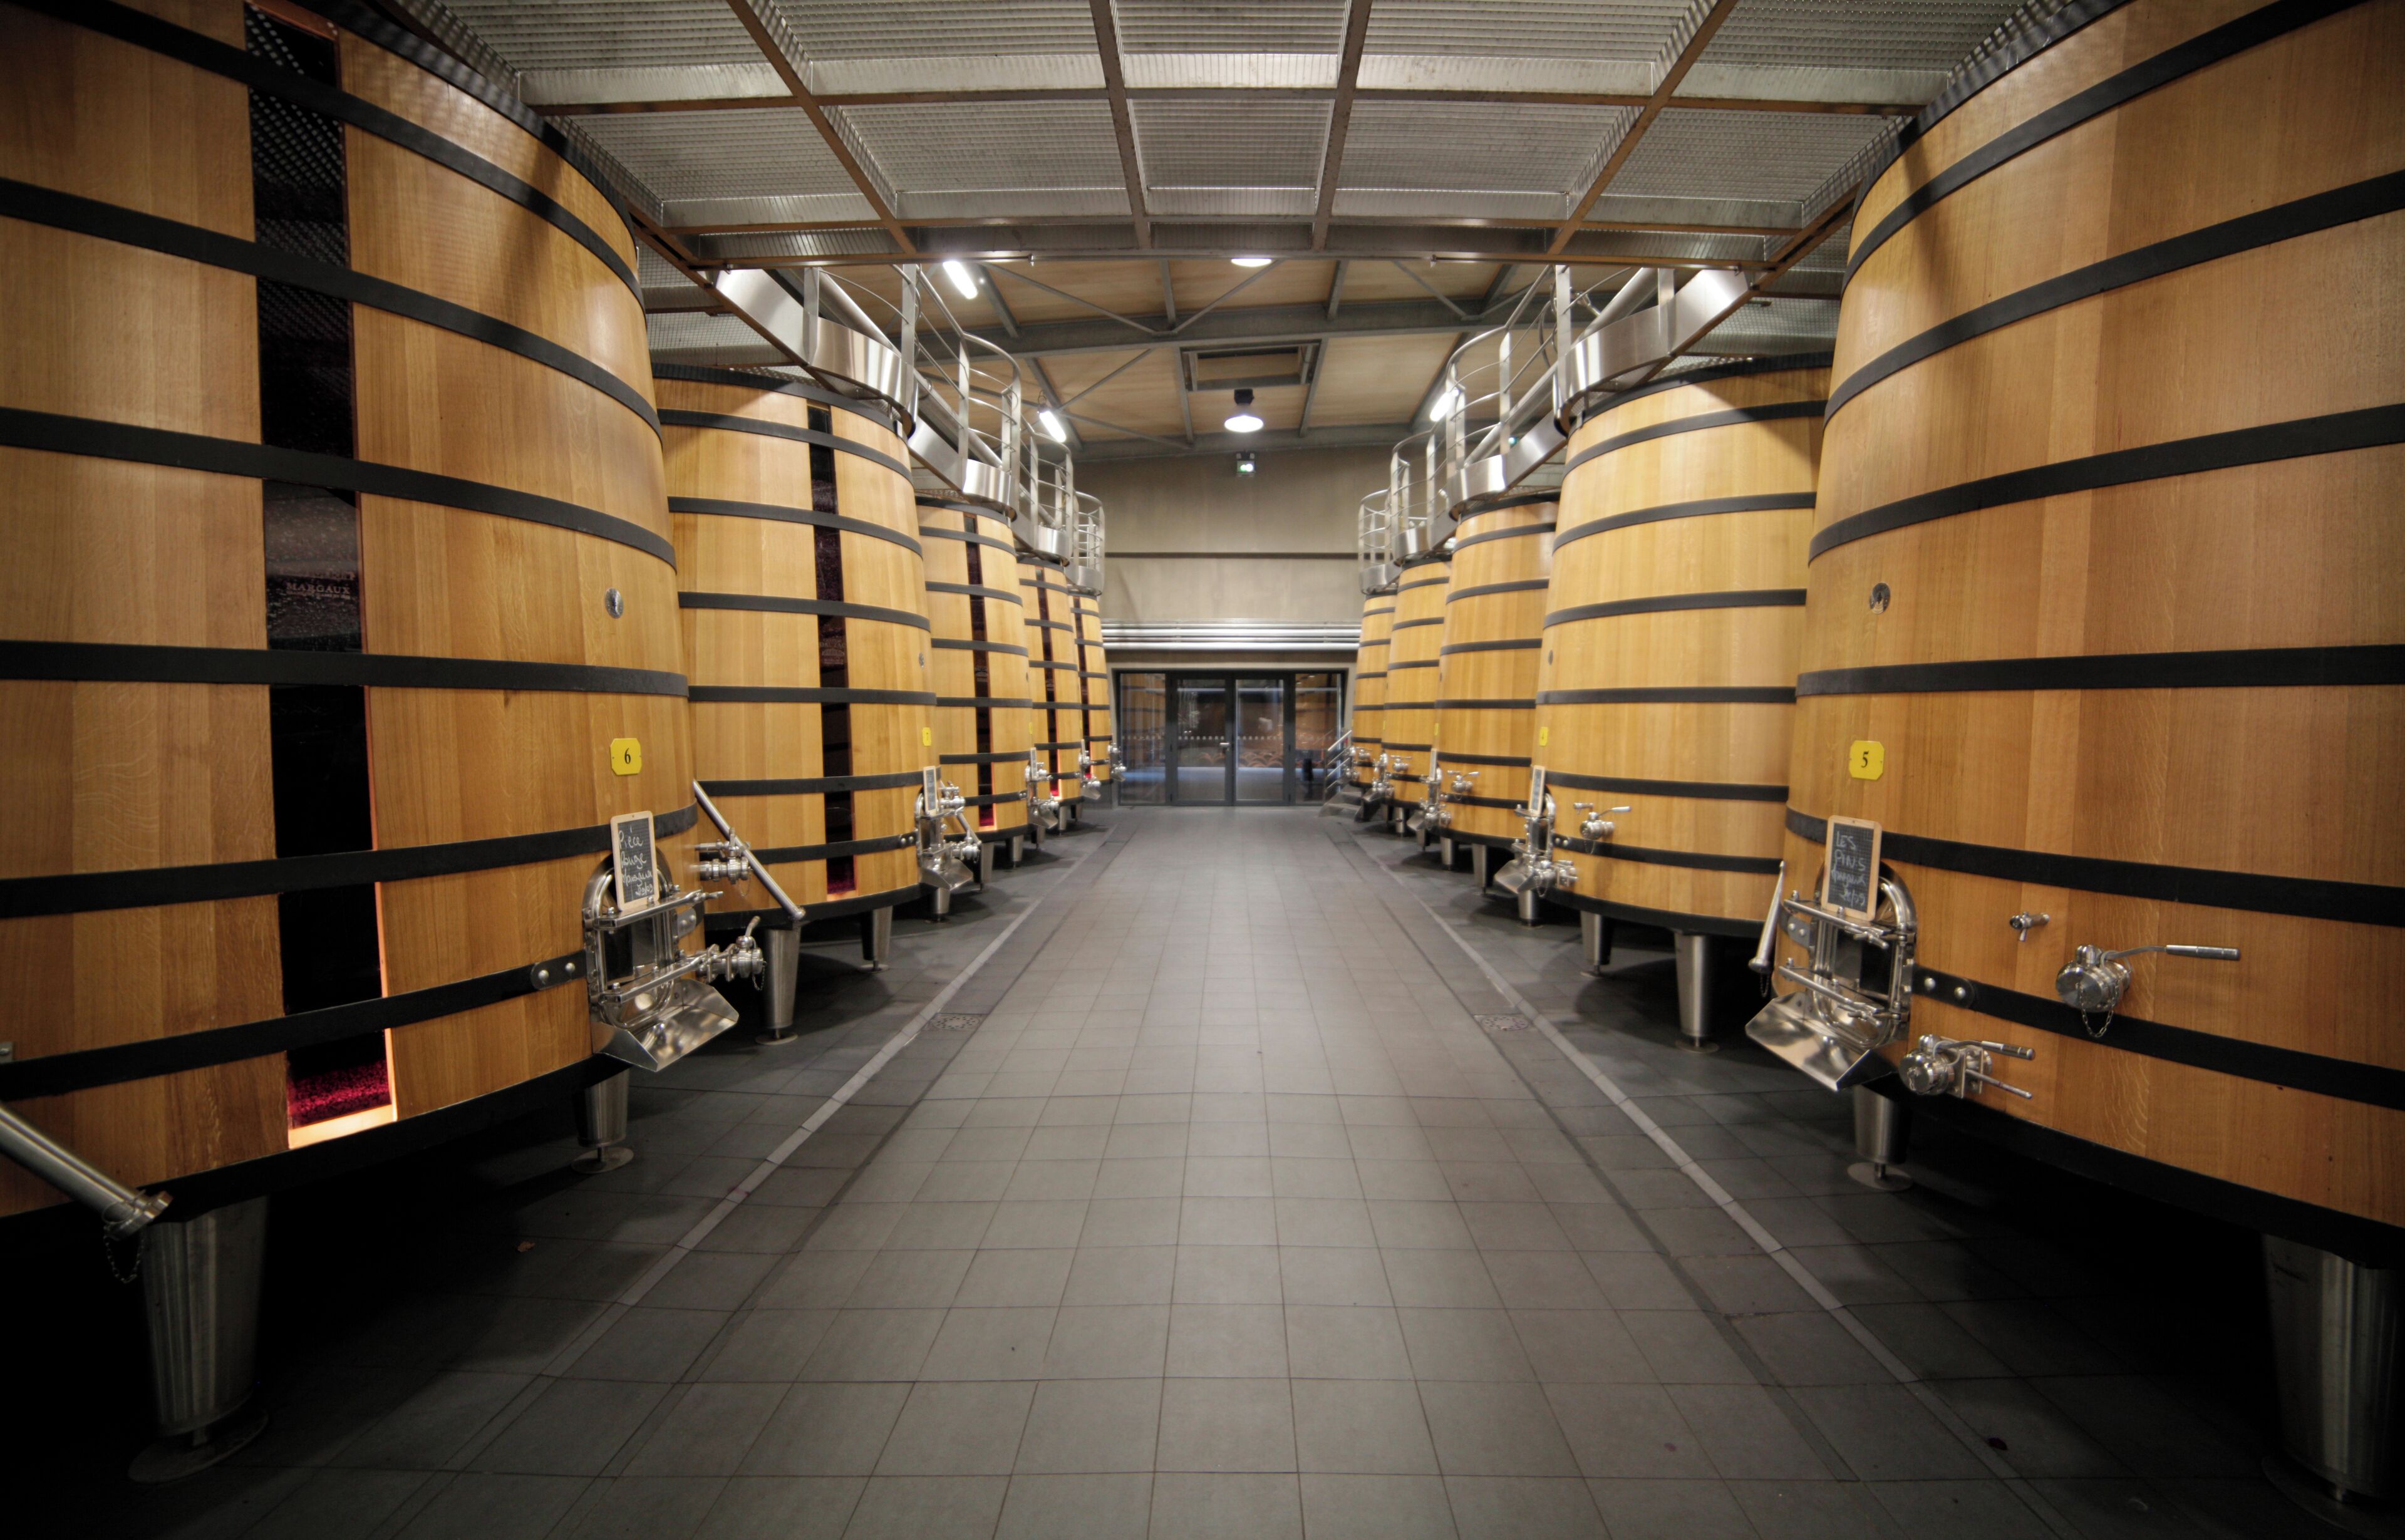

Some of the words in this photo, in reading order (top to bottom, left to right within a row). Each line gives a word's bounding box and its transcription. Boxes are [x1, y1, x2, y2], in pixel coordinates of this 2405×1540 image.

[286, 582, 351, 596] MARGAUX
[624, 747, 631, 765] 6
[1860, 750, 1870, 768] 5
[1836, 830, 1856, 850] LES
[621, 850, 647, 869] Rouge
[1834, 849, 1866, 872] PINS
